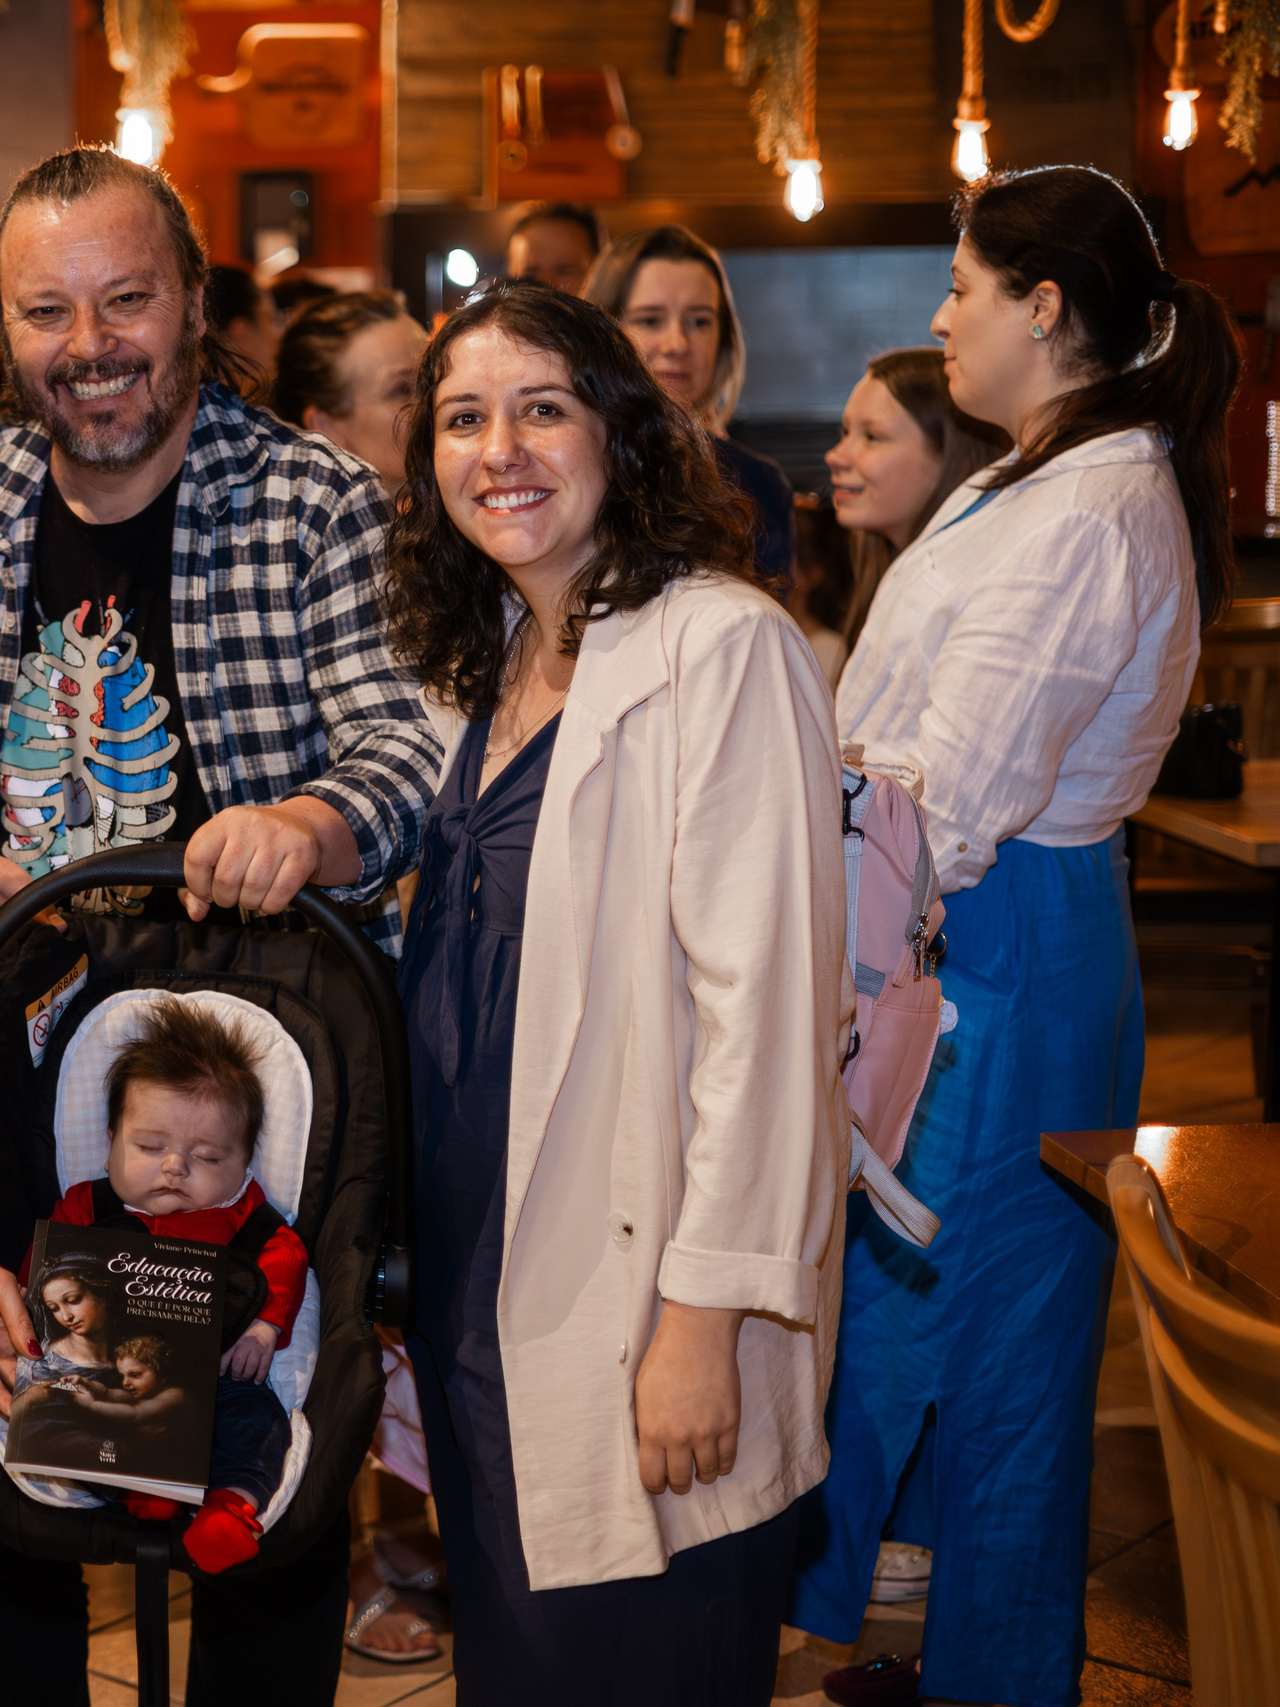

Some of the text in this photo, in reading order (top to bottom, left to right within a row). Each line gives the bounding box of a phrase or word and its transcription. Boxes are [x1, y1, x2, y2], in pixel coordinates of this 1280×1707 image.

[50, 967, 79, 1000] AIRBAG
[153, 1242, 217, 1258] Viviane Princival
[107, 1252, 215, 1285] Educação
[125, 1275, 213, 1304] Estética
[126, 1307, 211, 1326] PRECISAMOS DELA?
[127, 1298, 212, 1317] O QUE É E POR QUE
